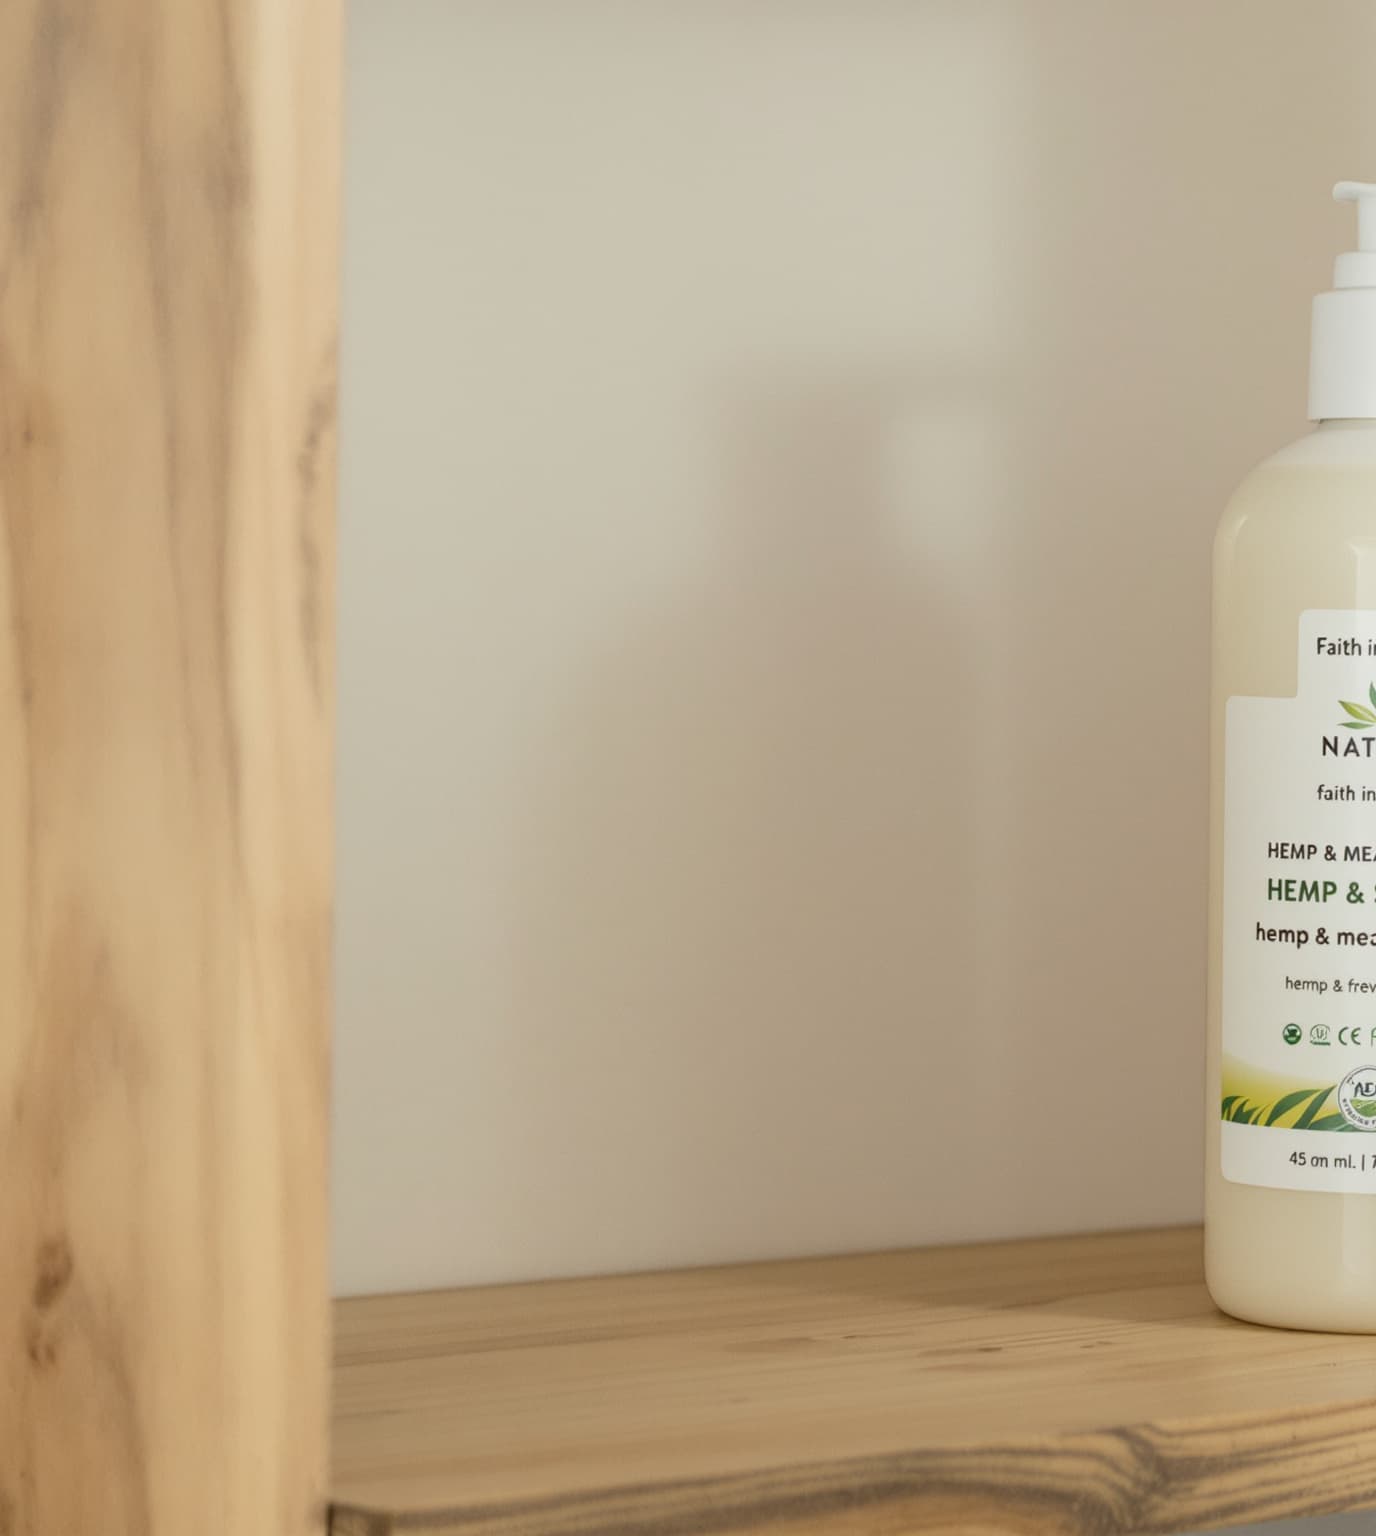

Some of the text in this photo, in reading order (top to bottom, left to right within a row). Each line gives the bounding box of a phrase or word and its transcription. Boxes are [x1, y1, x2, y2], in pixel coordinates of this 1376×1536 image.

[1316, 637, 1362, 656] Faith
[1317, 784, 1356, 802] faith
[1362, 786, 1376, 803] in
[1268, 842, 1318, 861] HEMP
[1324, 845, 1337, 862] &
[1268, 878, 1338, 903] HEMP
[1346, 881, 1365, 905] &
[1256, 921, 1309, 950] hemp
[1315, 927, 1330, 946] &
[1333, 979, 1343, 993] &
[1289, 1151, 1307, 1167] 45
